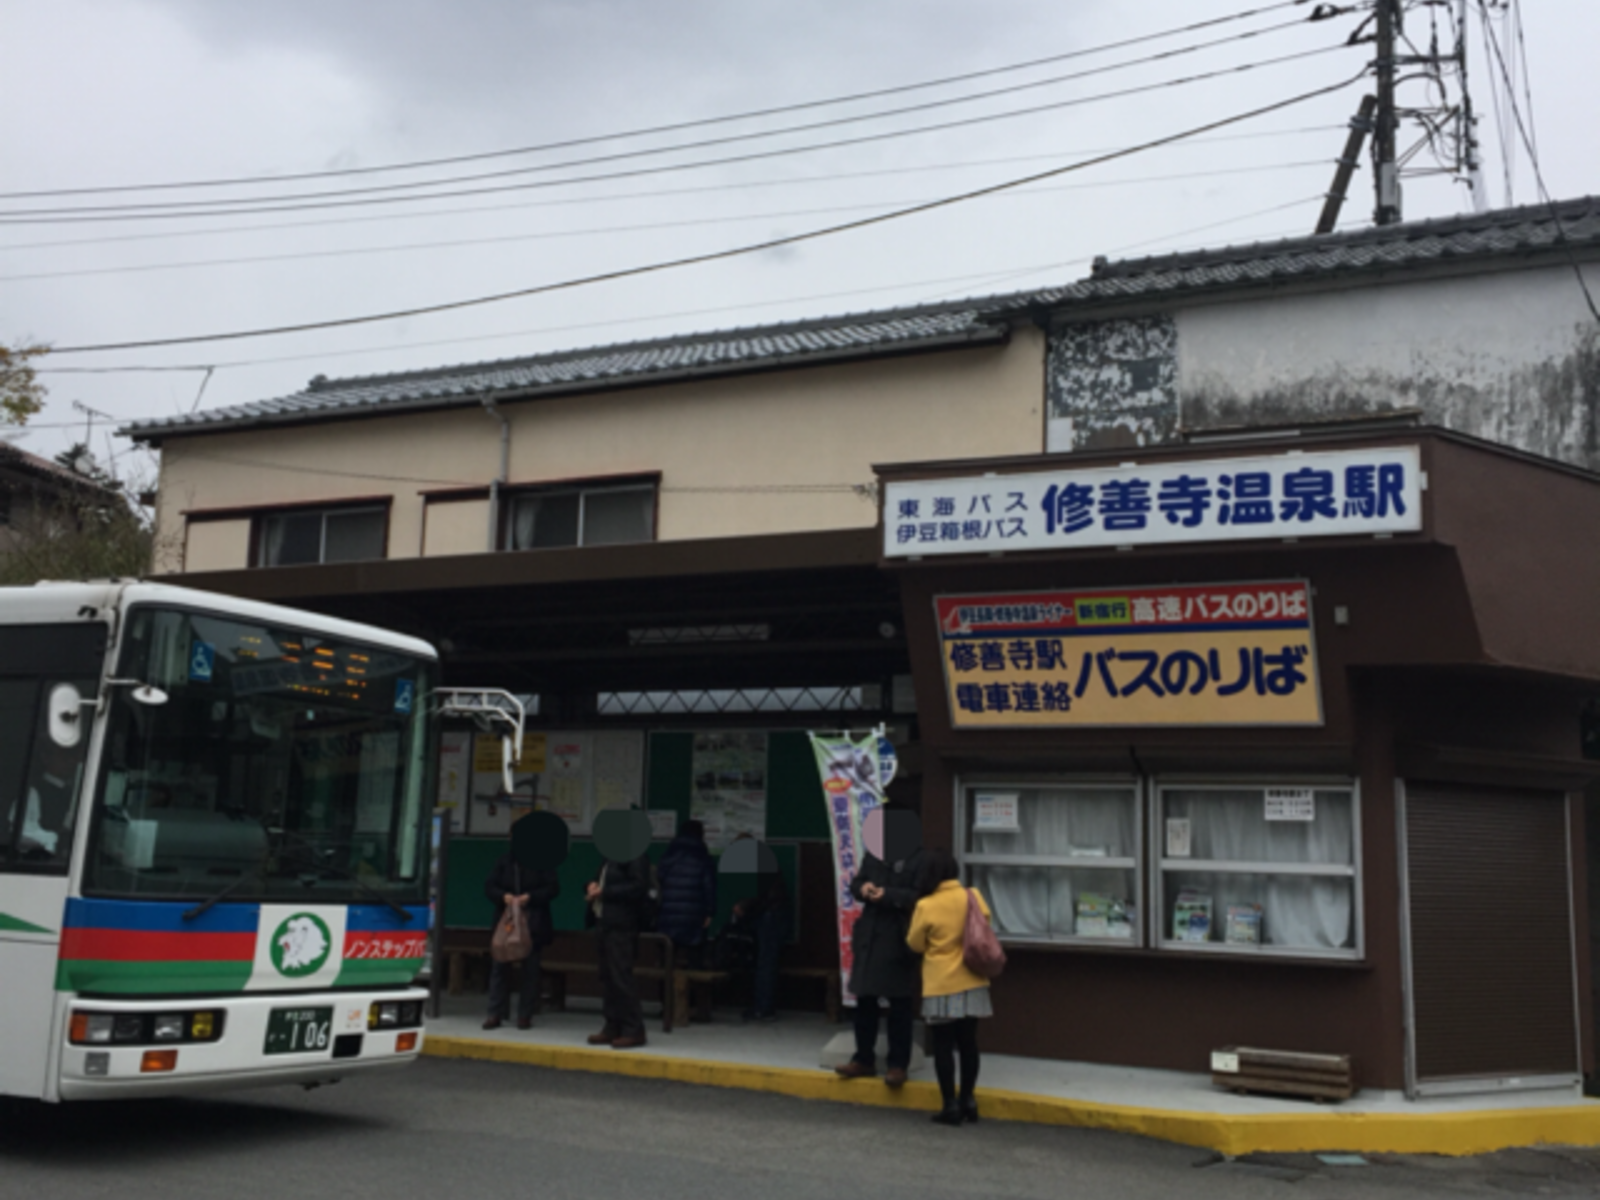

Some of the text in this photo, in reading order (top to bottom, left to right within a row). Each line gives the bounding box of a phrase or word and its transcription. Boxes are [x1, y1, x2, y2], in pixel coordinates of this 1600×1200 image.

[898, 463, 1406, 535] 東海バス 修善寺温泉駅
[897, 517, 1028, 544] 伊豆箱根バス
[1131, 590, 1306, 622] 高速バスのりば
[950, 639, 1067, 672] 修善寺駅
[1074, 644, 1308, 698] バスのりば
[956, 681, 1072, 713] 電車連絡
